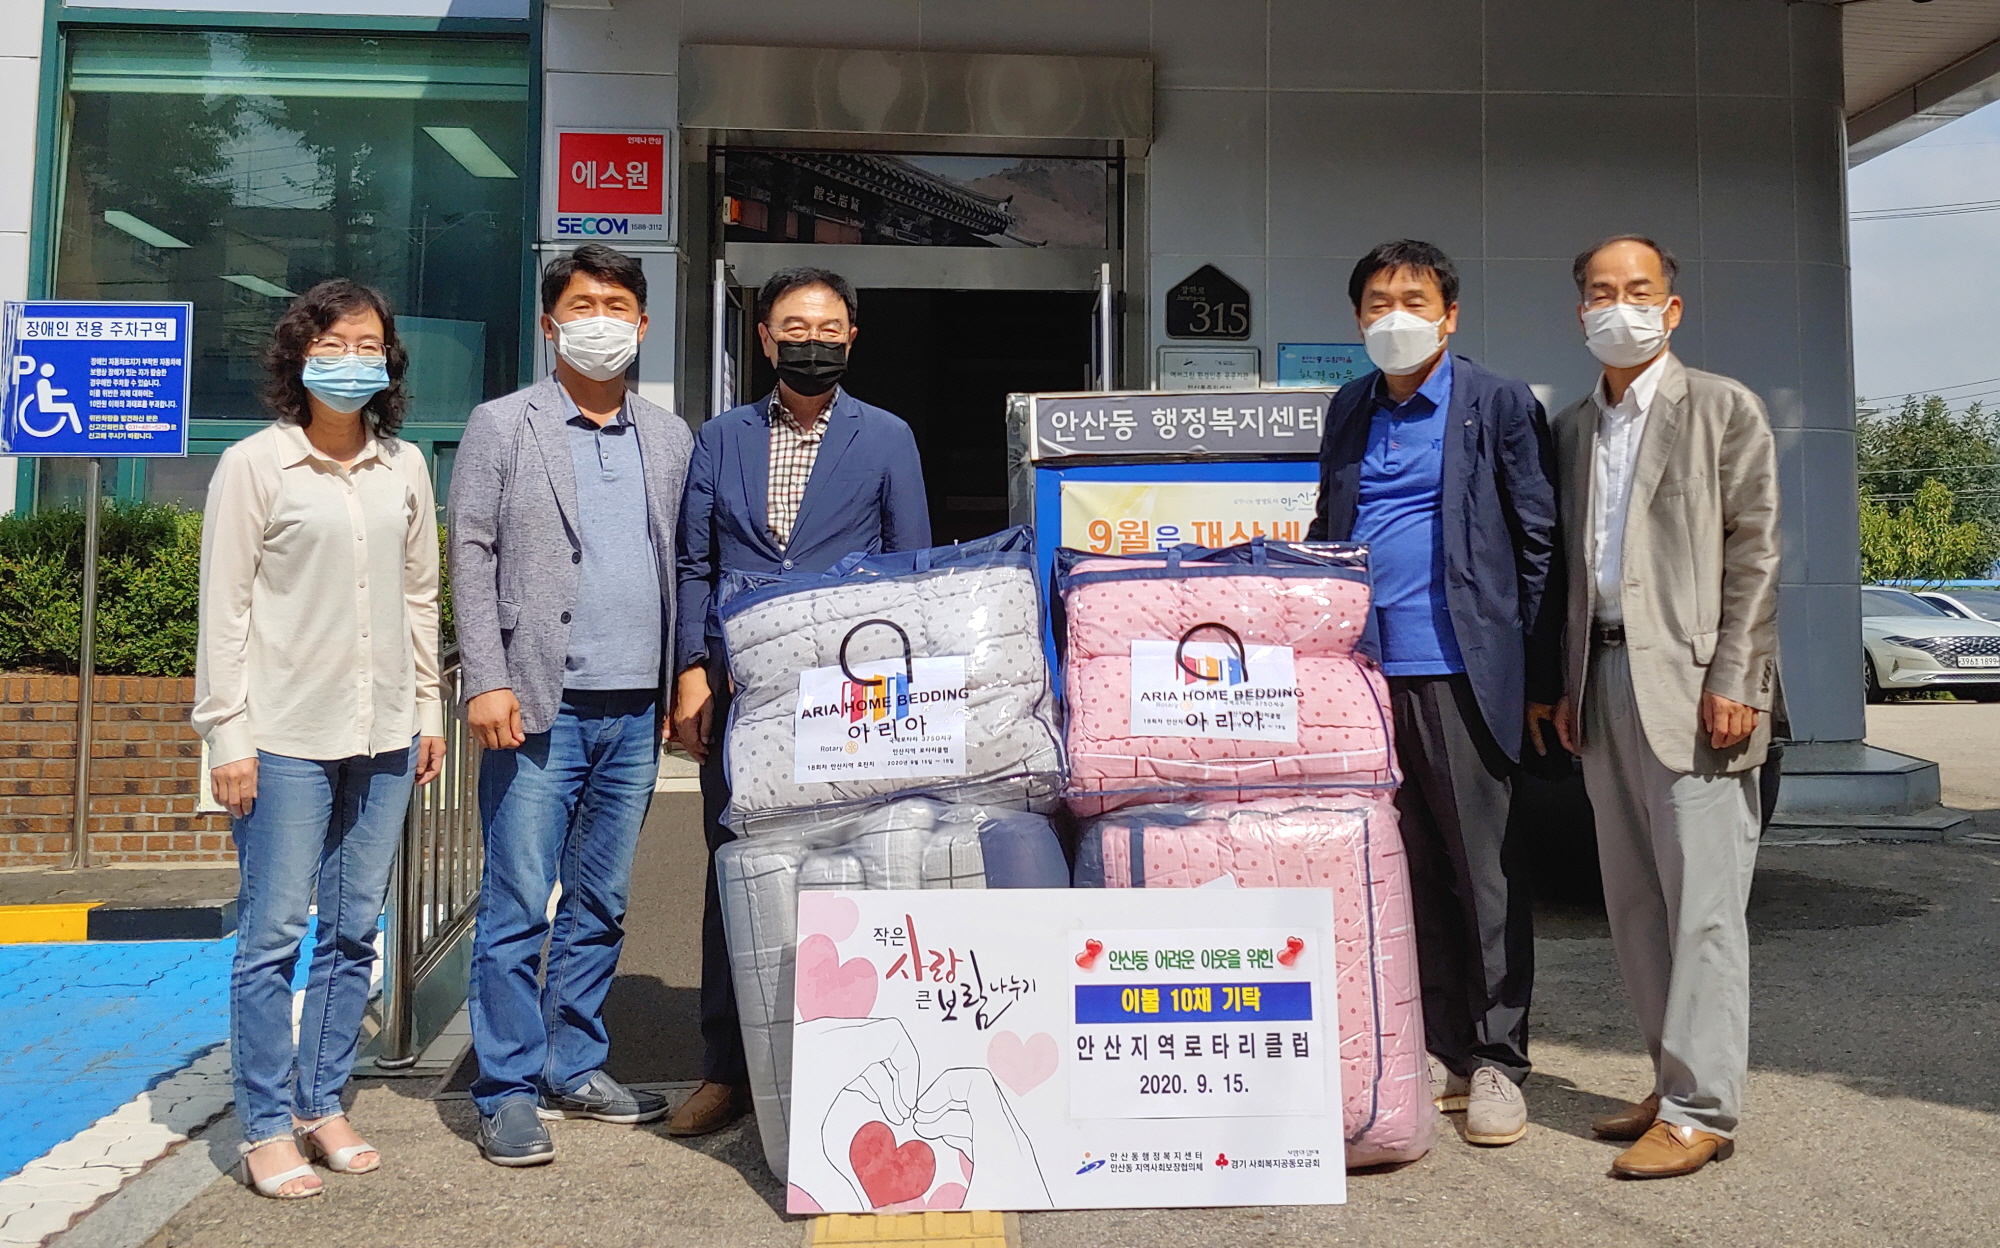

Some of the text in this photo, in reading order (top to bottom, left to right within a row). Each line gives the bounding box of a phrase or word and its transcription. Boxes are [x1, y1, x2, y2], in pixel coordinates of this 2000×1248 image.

[572, 161, 649, 190] 에스원
[558, 217, 628, 234] SECOM
[1189, 301, 1248, 334] 315
[26, 321, 167, 338] 장애인 전용 주차구역
[12, 356, 37, 385] P
[90, 368, 107, 376] 보행상
[108, 368, 125, 376] 장애가
[91, 358, 107, 366] 장애인
[142, 358, 159, 366] 부착된
[160, 358, 182, 366] 자동차에
[89, 389, 101, 397] 이를
[102, 389, 118, 397] 위반한
[90, 379, 112, 387] 경우에만
[113, 379, 129, 387] 주차할
[138, 379, 161, 387] 있습니다.
[148, 400, 178, 408] 부과합니다.
[1051, 406, 1322, 442] 안산동 행정복지센터
[1088, 520, 1180, 553] 9월은
[801, 688, 970, 719] ARIA HOME BEDDING
[1140, 687, 1305, 701] ARIA HOME BEDDING
[848, 715, 927, 743] 아리아
[1186, 711, 1264, 732] 아리아
[873, 914, 964, 983] 작은 사랑
[1108, 948, 1273, 970] 안산동 어려운 이웃을 위한
[915, 990, 932, 1009] 큰
[990, 975, 1036, 1000] 나누기
[1121, 986, 1261, 1013] 이불 10채 기탁
[1077, 1032, 1309, 1060] 안산지역로타리클럽
[1140, 1074, 1249, 1094] 2020. 9. 15.
[1110, 1162, 1203, 1172] 안산동 지역사회보장협의체
[1231, 1159, 1320, 1169] 경기 사회복지공동모금회
